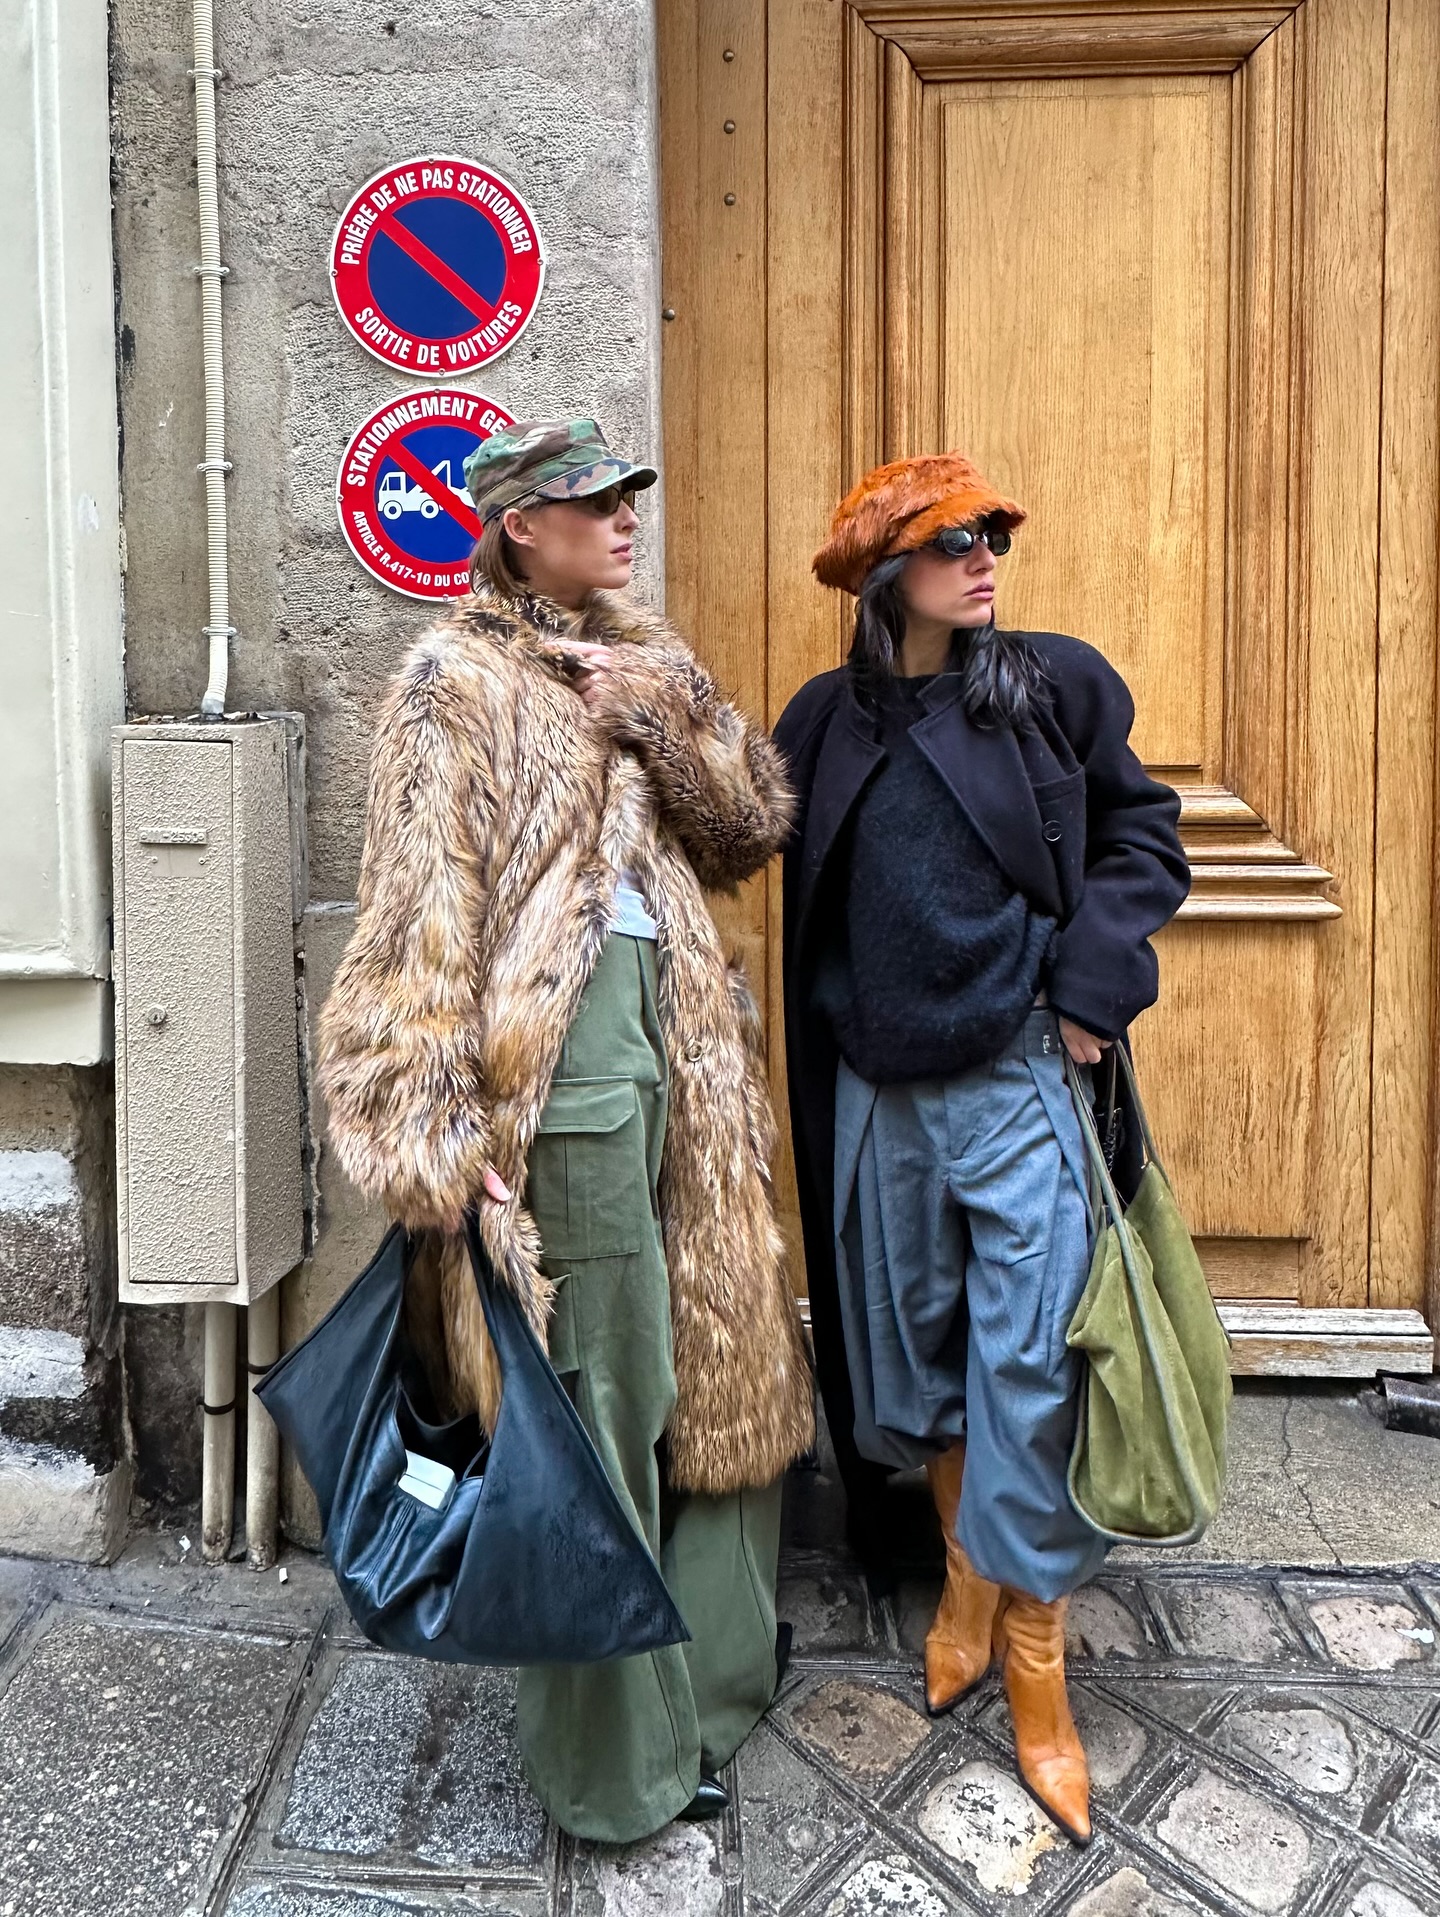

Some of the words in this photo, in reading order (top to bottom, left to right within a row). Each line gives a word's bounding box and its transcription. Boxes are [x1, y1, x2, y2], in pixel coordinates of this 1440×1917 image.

[341, 204, 378, 265] PRIÈRE
[370, 184, 396, 211] DE
[394, 172, 419, 197] NE
[422, 168, 454, 189] PAS
[457, 172, 532, 254] STATIONNER
[355, 307, 412, 360] SORTIE
[417, 344, 439, 365] DE
[446, 301, 522, 364] VOITURES
[347, 396, 478, 487] STATIONNEMENT
[479, 410, 508, 435] GE
[353, 511, 384, 557] ARTICLE
[379, 553, 431, 586] R.417-10
[434, 574, 450, 586] DU
[454, 571, 470, 585] CO
